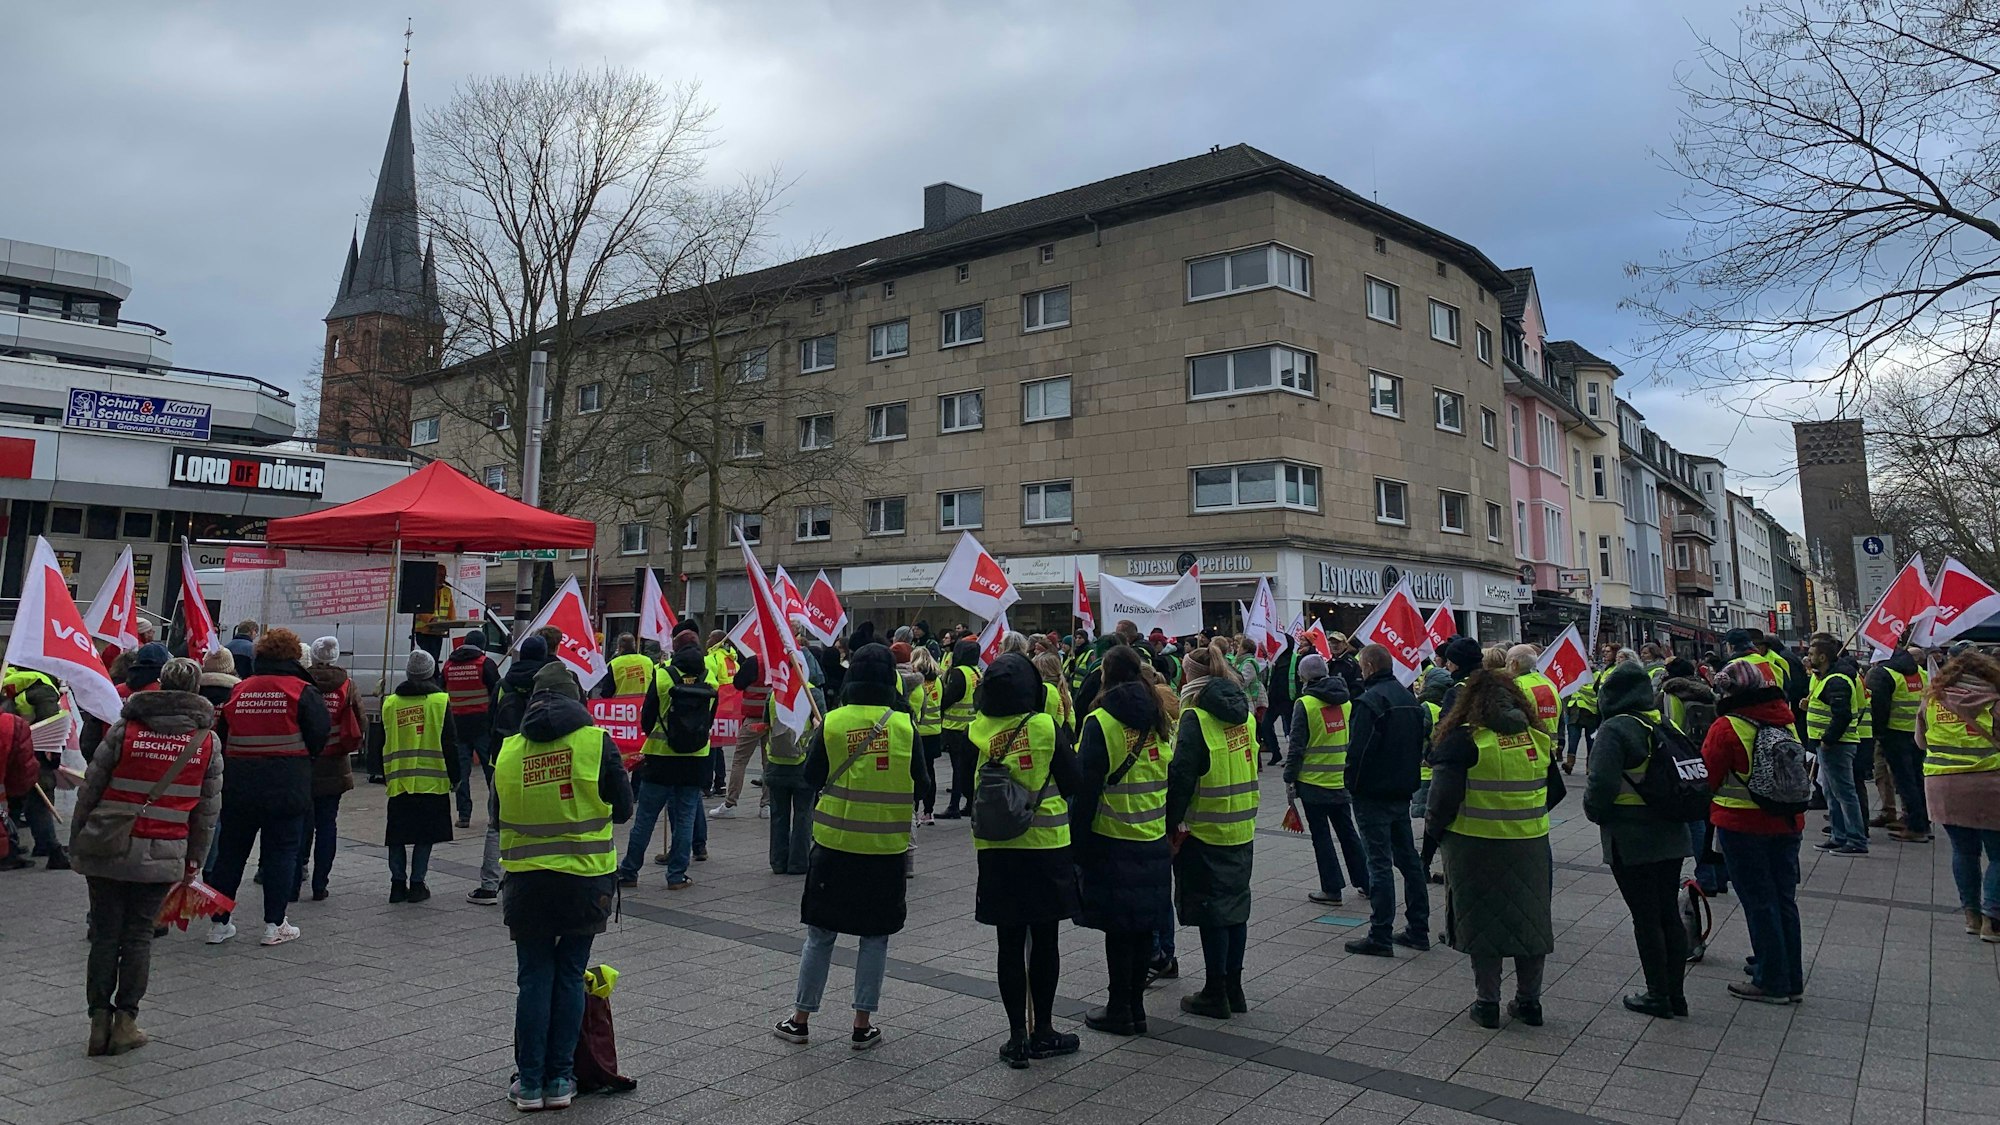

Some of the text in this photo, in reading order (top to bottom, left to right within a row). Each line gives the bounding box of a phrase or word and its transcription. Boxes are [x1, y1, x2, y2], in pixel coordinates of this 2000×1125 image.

[98, 395, 140, 411] Schuh
[140, 401, 155, 415] &
[166, 402, 205, 416] Krahn
[97, 407, 198, 429] Schlüsseldienst
[116, 423, 154, 434] Gravuren
[162, 428, 195, 437] Stempel
[174, 454, 324, 493] LORD OF DÖNER
[1127, 559, 1175, 576] Espresso
[1319, 561, 1381, 596] Espresso
[240, 691, 287, 699] SPARKASSEN-
[236, 699, 288, 708] BESCHÄFTIGTE
[847, 730, 889, 744] ZUSAEN
[132, 740, 203, 756] BESCHÄFTIE
[168, 754, 179, 762] AU
[523, 751, 572, 772] ZUSAMMEN
[523, 765, 572, 783] GEHT MEHR
